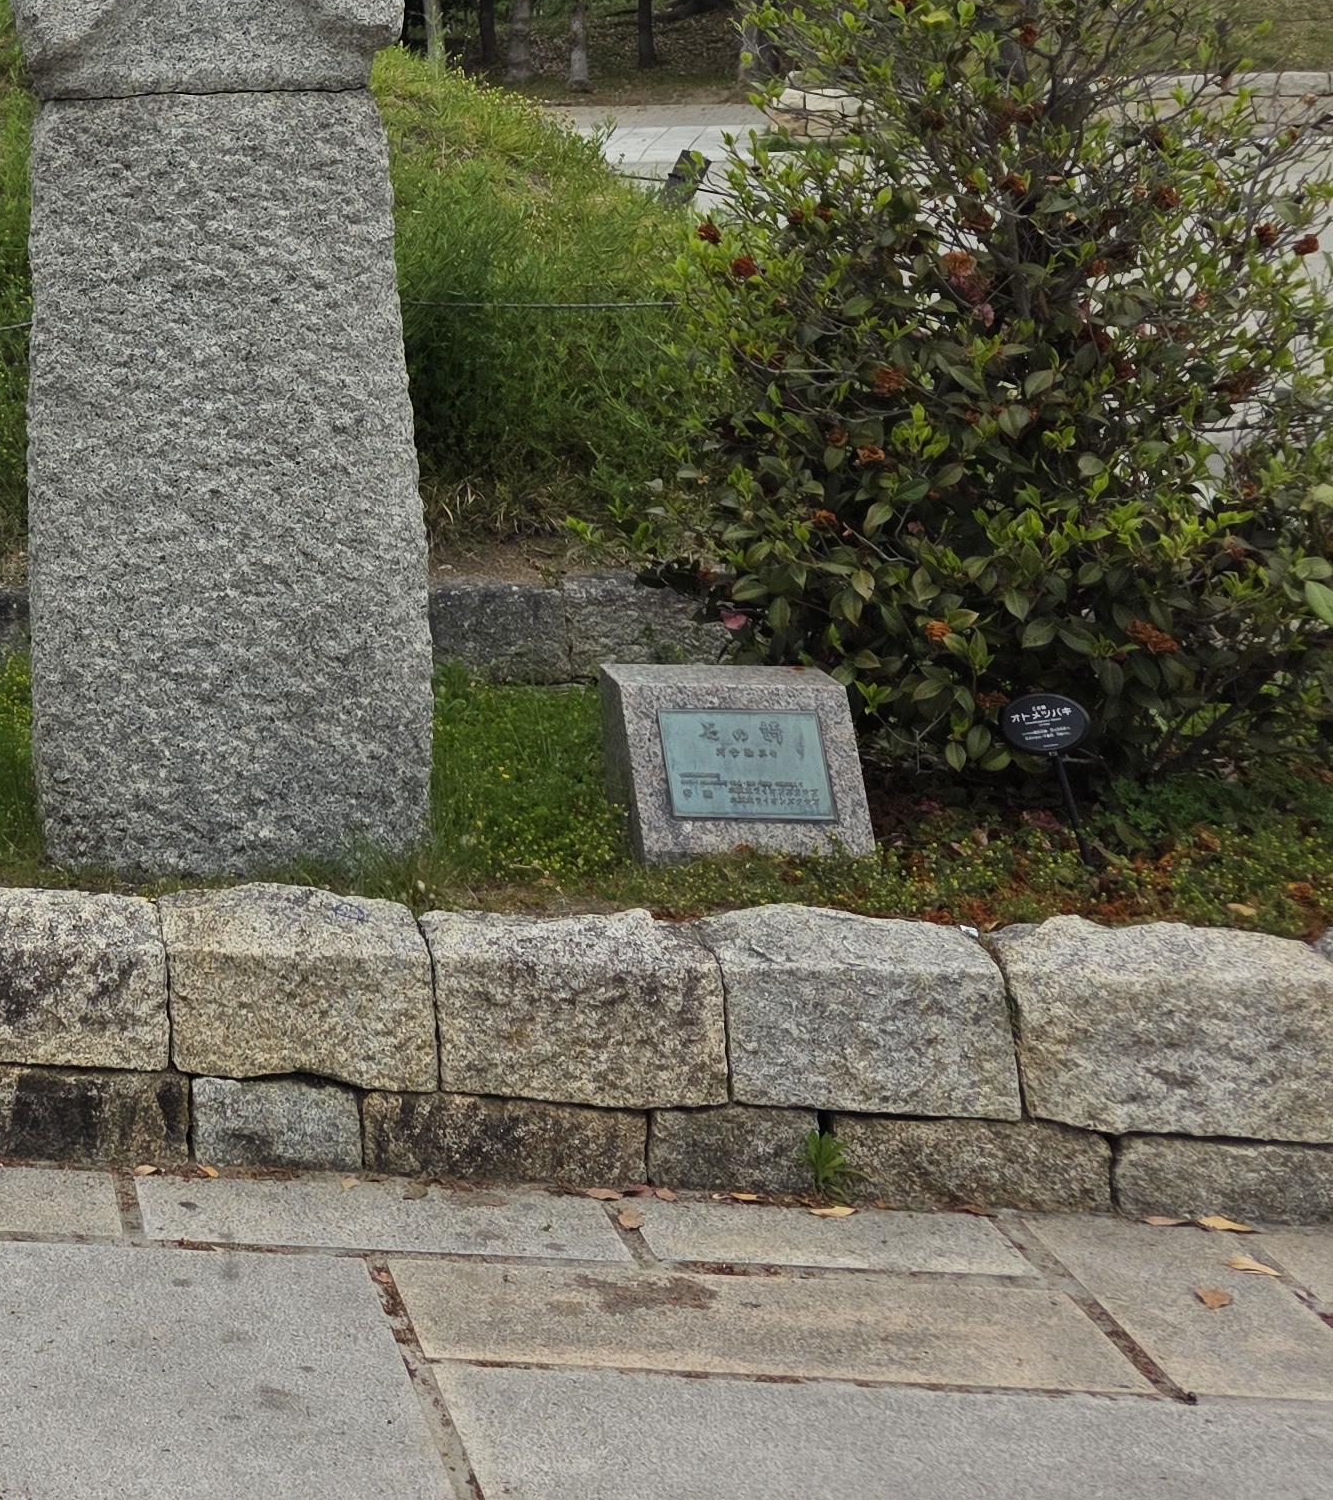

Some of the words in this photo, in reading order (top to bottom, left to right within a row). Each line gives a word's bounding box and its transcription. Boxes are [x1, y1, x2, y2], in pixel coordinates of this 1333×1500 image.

[1010, 706, 1072, 723] オトメツバキ
